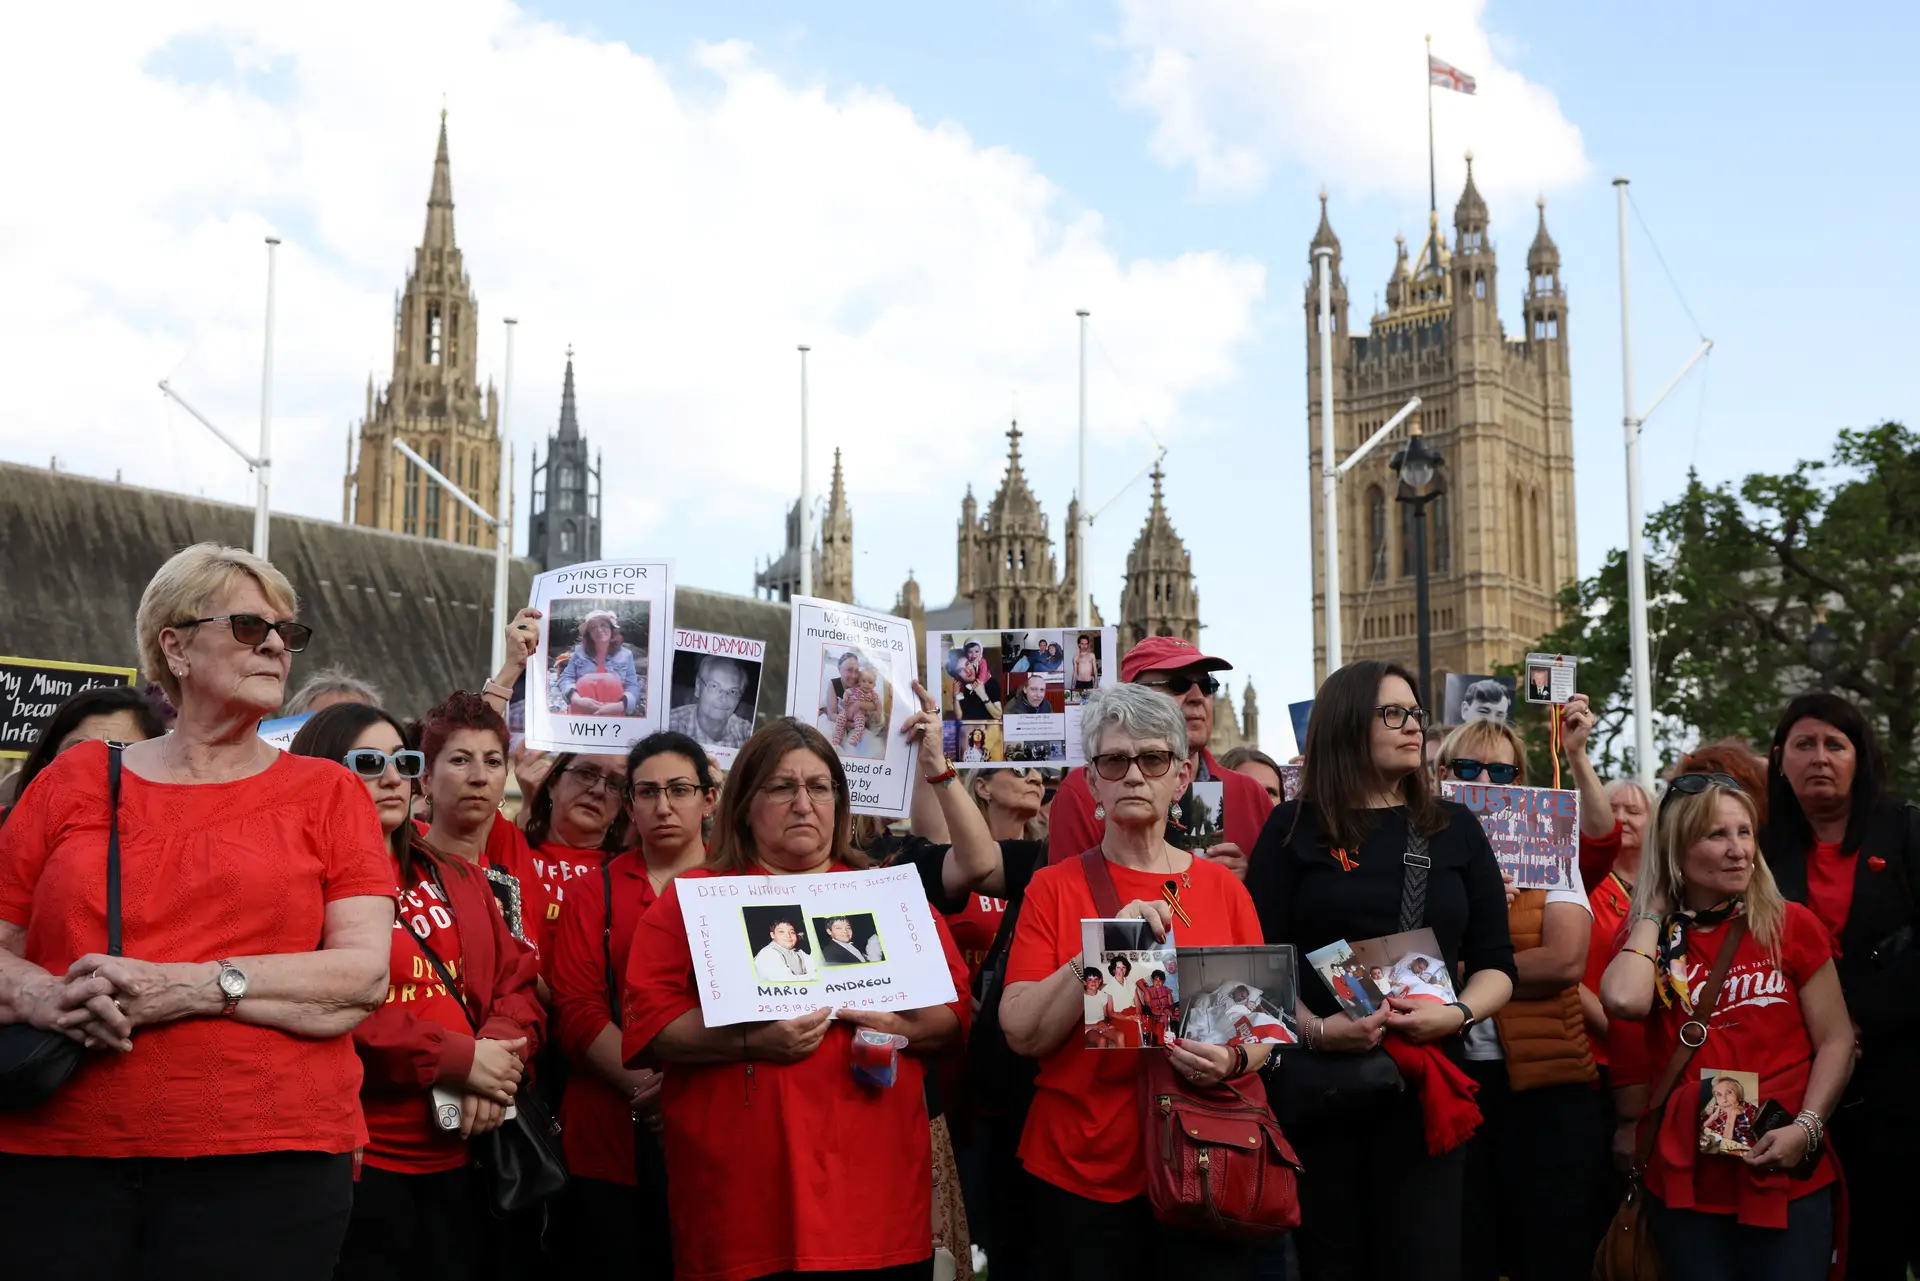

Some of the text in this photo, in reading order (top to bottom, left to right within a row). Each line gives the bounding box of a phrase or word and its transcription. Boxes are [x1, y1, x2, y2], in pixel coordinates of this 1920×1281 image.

[557, 566, 648, 584] DYING FOR
[566, 582, 636, 595] JUSTICE
[823, 611, 888, 634] My daughter
[675, 631, 709, 650] JOHN
[807, 627, 904, 652] murdered aged 28
[28, 672, 73, 696] Mum
[569, 722, 622, 738] WHY ?
[872, 764, 884, 775] of
[884, 767, 892, 776] a
[859, 777, 872, 791] by
[850, 791, 880, 804] Blood
[1515, 819, 1554, 838] ALL
[1523, 842, 1577, 859] BLOOD
[697, 872, 909, 898] DIED WITHOUT GETTING JUSTICE
[698, 914, 722, 1001] INFECTED
[757, 977, 892, 997] MARIO ANDREOU
